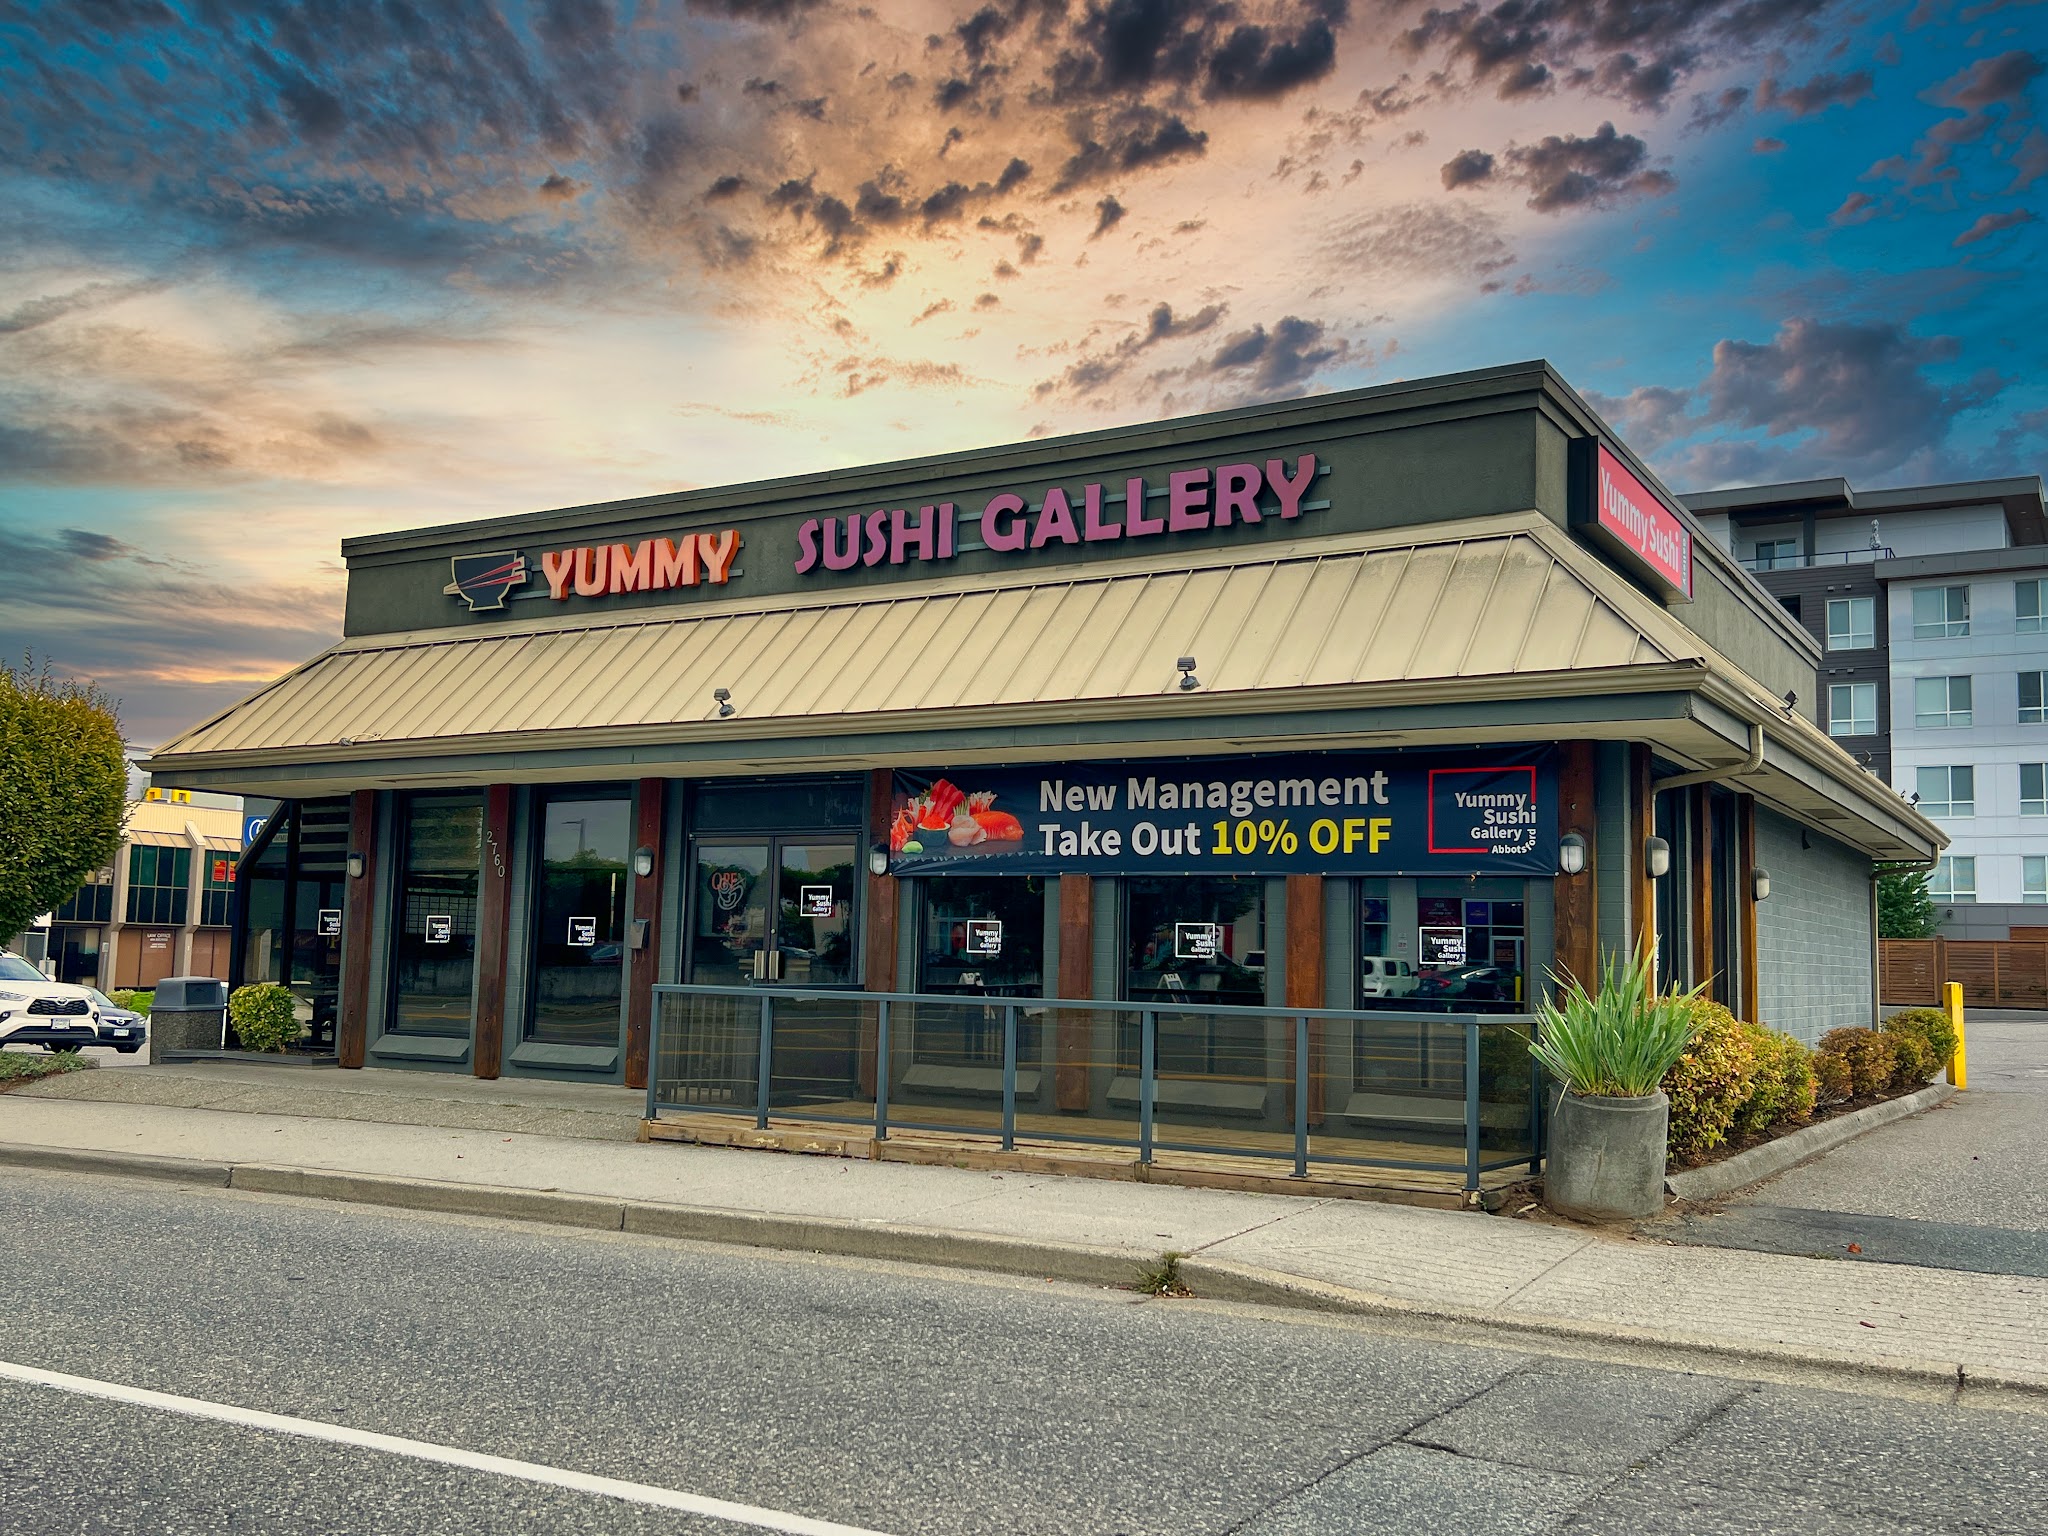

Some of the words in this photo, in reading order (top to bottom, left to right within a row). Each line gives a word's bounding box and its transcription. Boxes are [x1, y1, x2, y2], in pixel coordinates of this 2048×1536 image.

[542, 529, 740, 600] YUMMY
[794, 501, 959, 575] SUSHI
[981, 453, 1316, 552] GALLERY
[1601, 466, 1648, 553] Yummy
[1649, 514, 1679, 573] Sushi
[1040, 780, 1117, 812] New
[1127, 770, 1389, 818] Management
[1455, 792, 1527, 811] Yummy
[1483, 804, 1537, 825] Sushi
[1038, 821, 1122, 857] Take
[1131, 821, 1201, 856] Out
[1211, 819, 1299, 856] 10%
[1309, 818, 1392, 855] OFF
[1470, 826, 1522, 842] Gallery
[486, 830, 505, 878] 2760
[808, 894, 830, 902] Yummy
[975, 929, 999, 937] Yummy
[1185, 932, 1212, 941] Yummy
[1195, 938, 1216, 947] Sushi
[1431, 937, 1462, 947] Yummy
[1442, 943, 1466, 953] Sushi
[1437, 952, 1461, 960] Gallery
